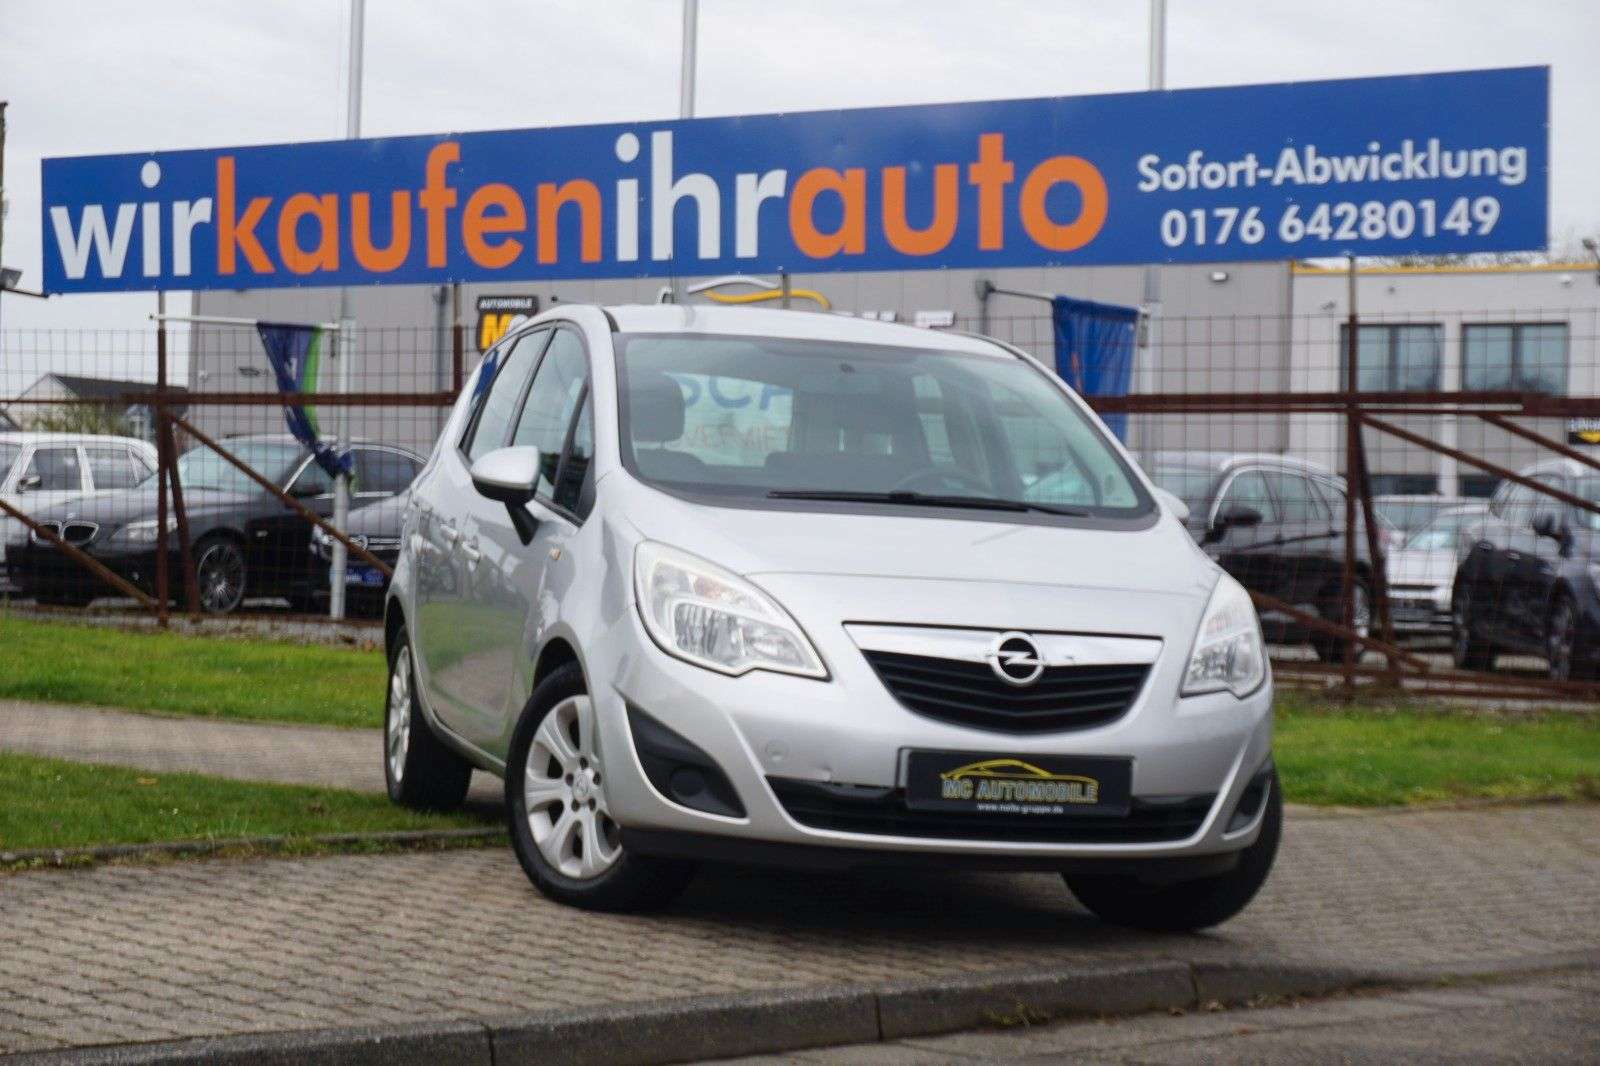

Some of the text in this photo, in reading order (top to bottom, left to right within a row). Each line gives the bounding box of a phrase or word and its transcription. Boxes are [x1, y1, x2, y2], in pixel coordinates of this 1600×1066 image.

[1138, 138, 1527, 192] Sofort-Abwicklung
[1161, 197, 1500, 246] 0176 64280149
[941, 778, 1099, 804] MC AUTOMOBILE
